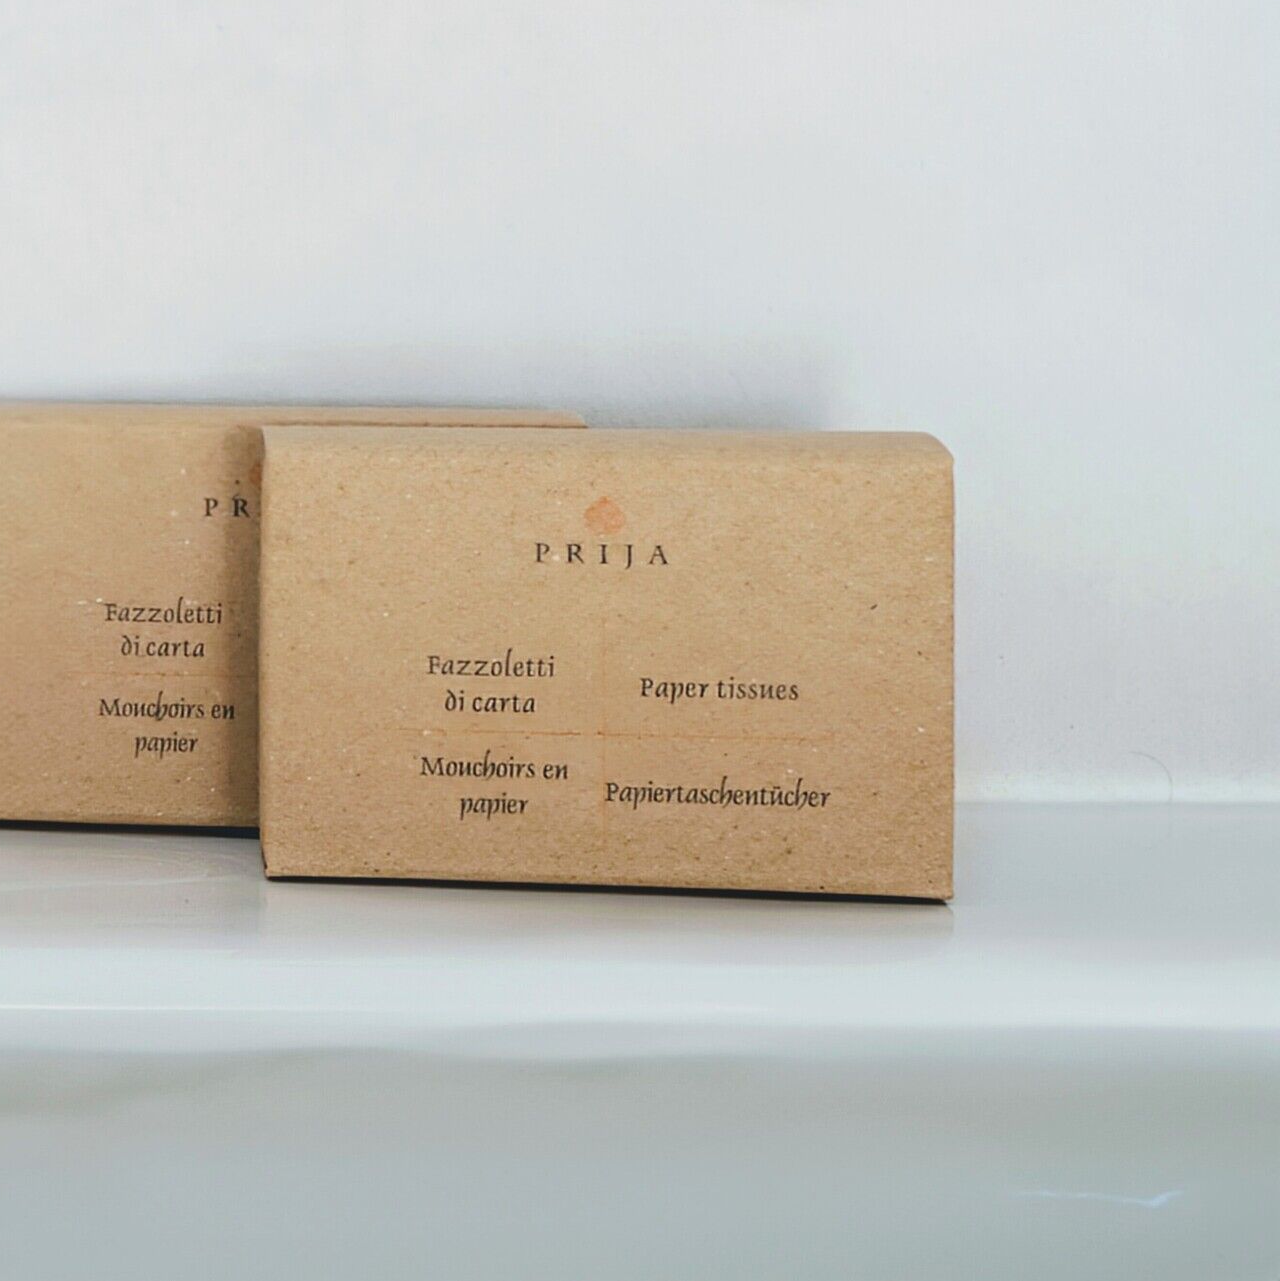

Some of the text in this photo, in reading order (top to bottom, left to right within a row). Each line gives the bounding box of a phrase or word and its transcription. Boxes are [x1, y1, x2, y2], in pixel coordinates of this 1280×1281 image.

[534, 541, 671, 571] PRIJA
[102, 595, 225, 626] Fazzoletti
[119, 633, 207, 660] di carta
[426, 647, 557, 679] Fazzoletti
[97, 689, 237, 722] Mouchoirs en
[443, 688, 538, 714] di carta
[639, 676, 801, 705] Paper tissues
[132, 731, 200, 761] papier
[419, 748, 570, 782] Mouchoirs en
[458, 790, 530, 822] papier
[603, 774, 833, 813] Papiertaschentücher
